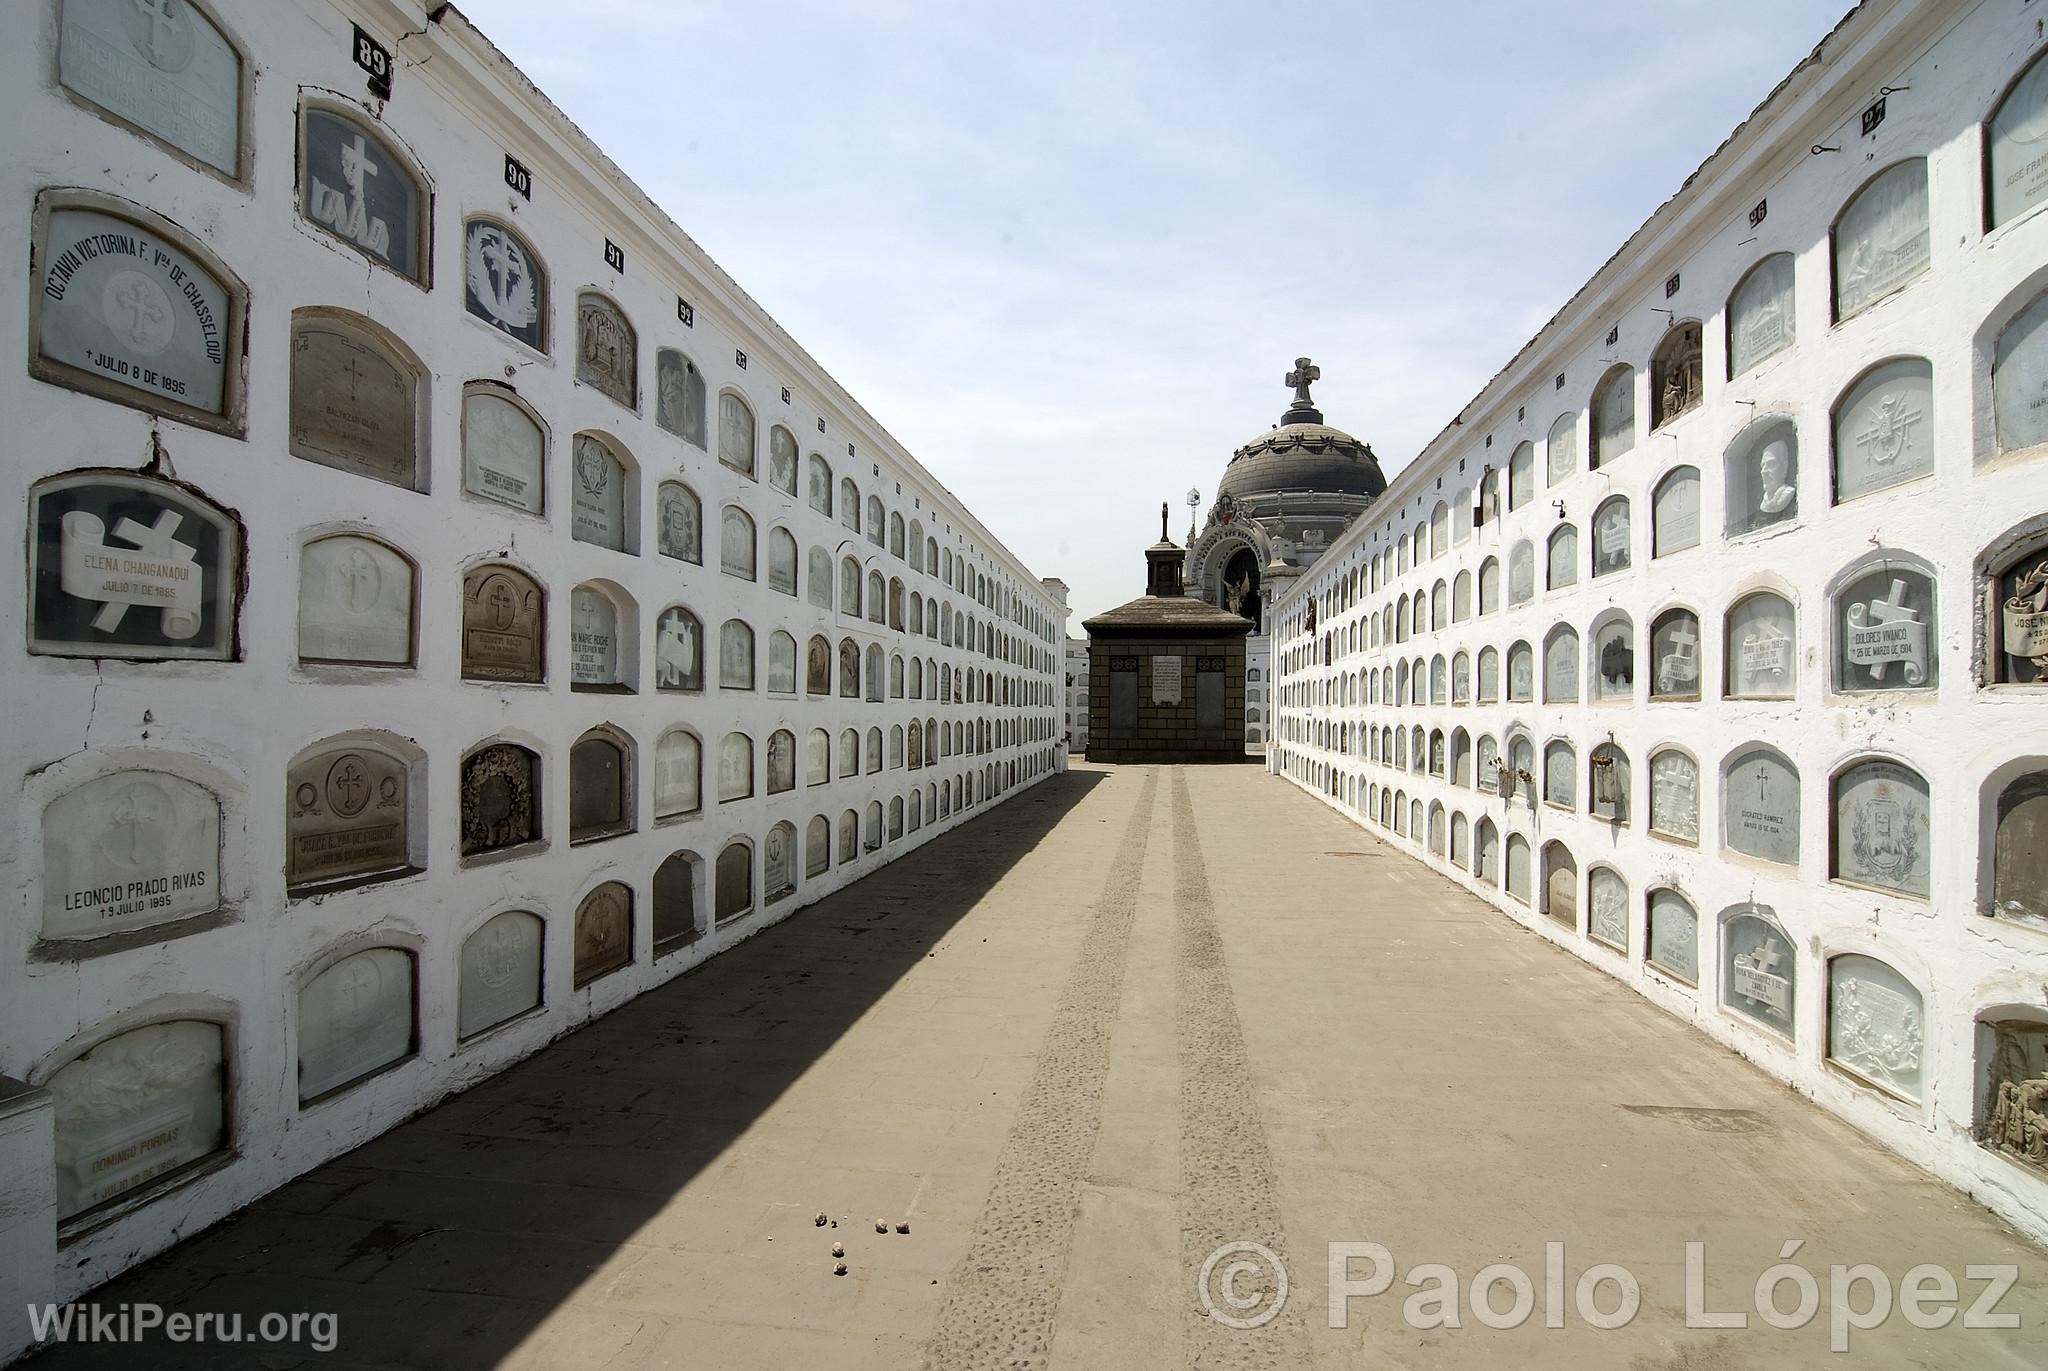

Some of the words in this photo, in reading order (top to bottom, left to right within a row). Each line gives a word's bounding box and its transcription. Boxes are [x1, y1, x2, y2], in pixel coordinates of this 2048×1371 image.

[359, 37, 386, 75] 89
[1864, 102, 1884, 133] 97
[508, 164, 527, 191] 90
[1749, 203, 1766, 227] 96
[608, 243, 622, 271] 91
[46, 248, 83, 301] OCTAVIA
[74, 234, 136, 262] VICTORINA
[139, 241, 148, 262] F.
[170, 264, 188, 287] DE
[183, 283, 222, 365] CHASSELOUP
[679, 303, 693, 325] 92
[737, 351, 747, 368] 93
[95, 353, 128, 375] JULIO
[132, 365, 140, 380] 8
[143, 371, 158, 387] DE
[162, 375, 188, 397] 1895.
[85, 554, 119, 572] ELENA
[102, 580, 130, 594] JULIO
[142, 585, 153, 596] DE
[2014, 617, 2038, 628] JOSE
[578, 632, 593, 645] MARIE
[593, 634, 609, 647] ROCHE
[1855, 631, 1881, 645] DOLORES
[1882, 628, 1907, 642] VIVANCO
[1856, 647, 1864, 658] 25
[1864, 647, 1872, 657] DE
[1872, 645, 1890, 656] MARZO
[1890, 644, 1899, 655] DE
[1900, 643, 1912, 653] 1904
[65, 885, 123, 911] LEONCIO
[128, 877, 168, 899] PRADO
[173, 870, 206, 892] RIVAS
[109, 906, 115, 918] 9
[117, 899, 145, 916] JULIO
[92, 1143, 137, 1174] DOMINGO
[140, 1127, 179, 1155] PORRAS
[102, 1178, 129, 1200] JULIO
[143, 1166, 156, 1181] DE
